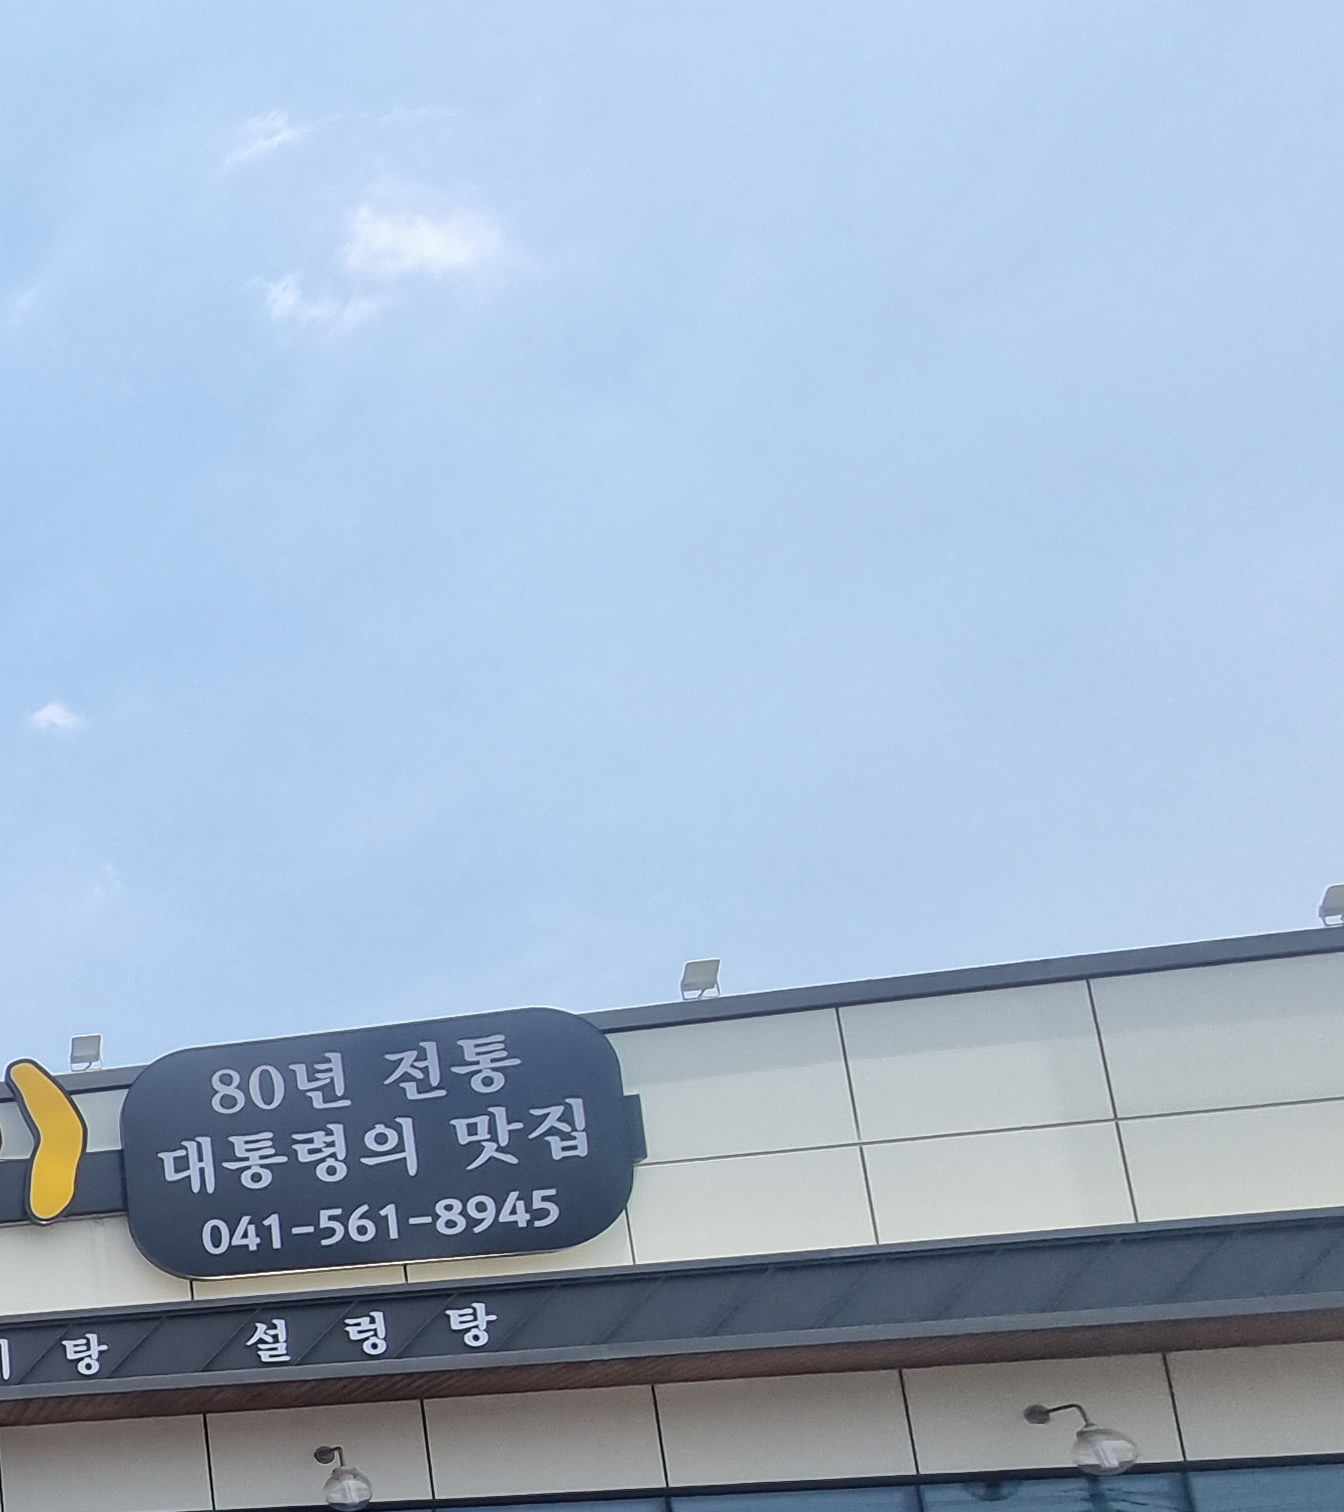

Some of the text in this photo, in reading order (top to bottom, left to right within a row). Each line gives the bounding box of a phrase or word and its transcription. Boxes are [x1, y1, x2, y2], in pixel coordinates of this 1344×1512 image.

[210, 1034, 522, 1115] 80년 전통
[156, 1098, 590, 1195] 대통령의 맛집
[201, 1188, 561, 1257] 041-561-8945
[245, 1302, 499, 1363] 설렁탕
